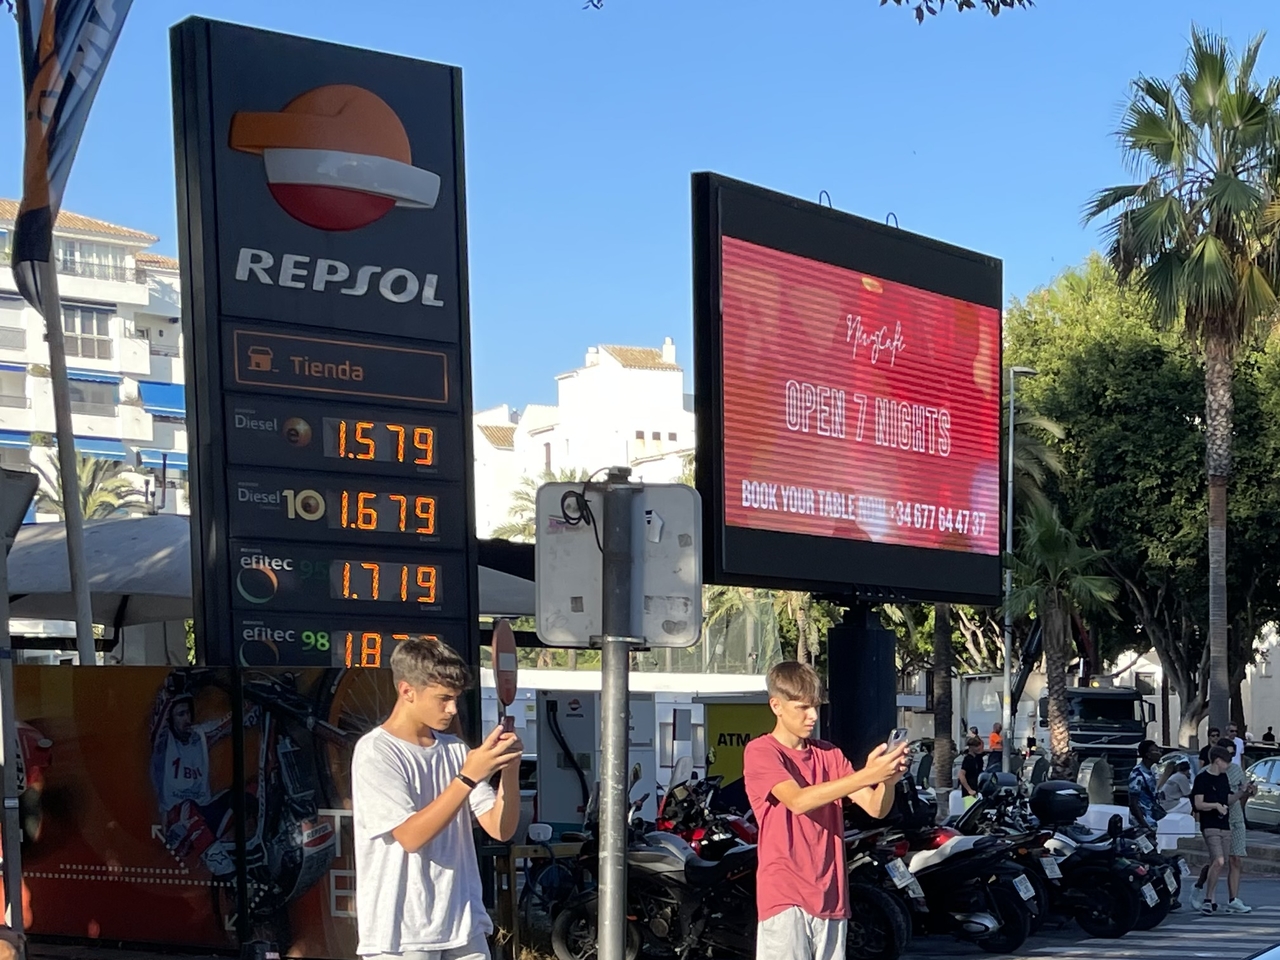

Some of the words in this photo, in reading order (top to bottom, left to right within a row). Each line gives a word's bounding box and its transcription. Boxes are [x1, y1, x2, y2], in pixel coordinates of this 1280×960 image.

[235, 247, 444, 307] REPSOL
[289, 355, 364, 381] Tienda
[234, 414, 278, 431] Diesel
[338, 420, 434, 466] 1.579
[785, 379, 846, 439] OPEN
[853, 393, 868, 442] 7
[875, 397, 951, 457] NIGHTS
[237, 487, 280, 504] Diesel
[281, 489, 326, 521] 10
[341, 490, 435, 535] 1.679
[741, 479, 778, 511] BOOK
[780, 485, 815, 515] YOUR
[817, 489, 856, 520] TABLE
[914, 503, 936, 530] 677
[938, 506, 954, 533] 64
[955, 509, 970, 534] 47
[972, 511, 986, 536] 37
[240, 554, 293, 571] efitec
[343, 562, 436, 603] 1.719
[242, 627, 295, 642] efitec
[301, 630, 330, 651] 98
[345, 632, 438, 668] 1.8
[717, 732, 751, 747] ATM
